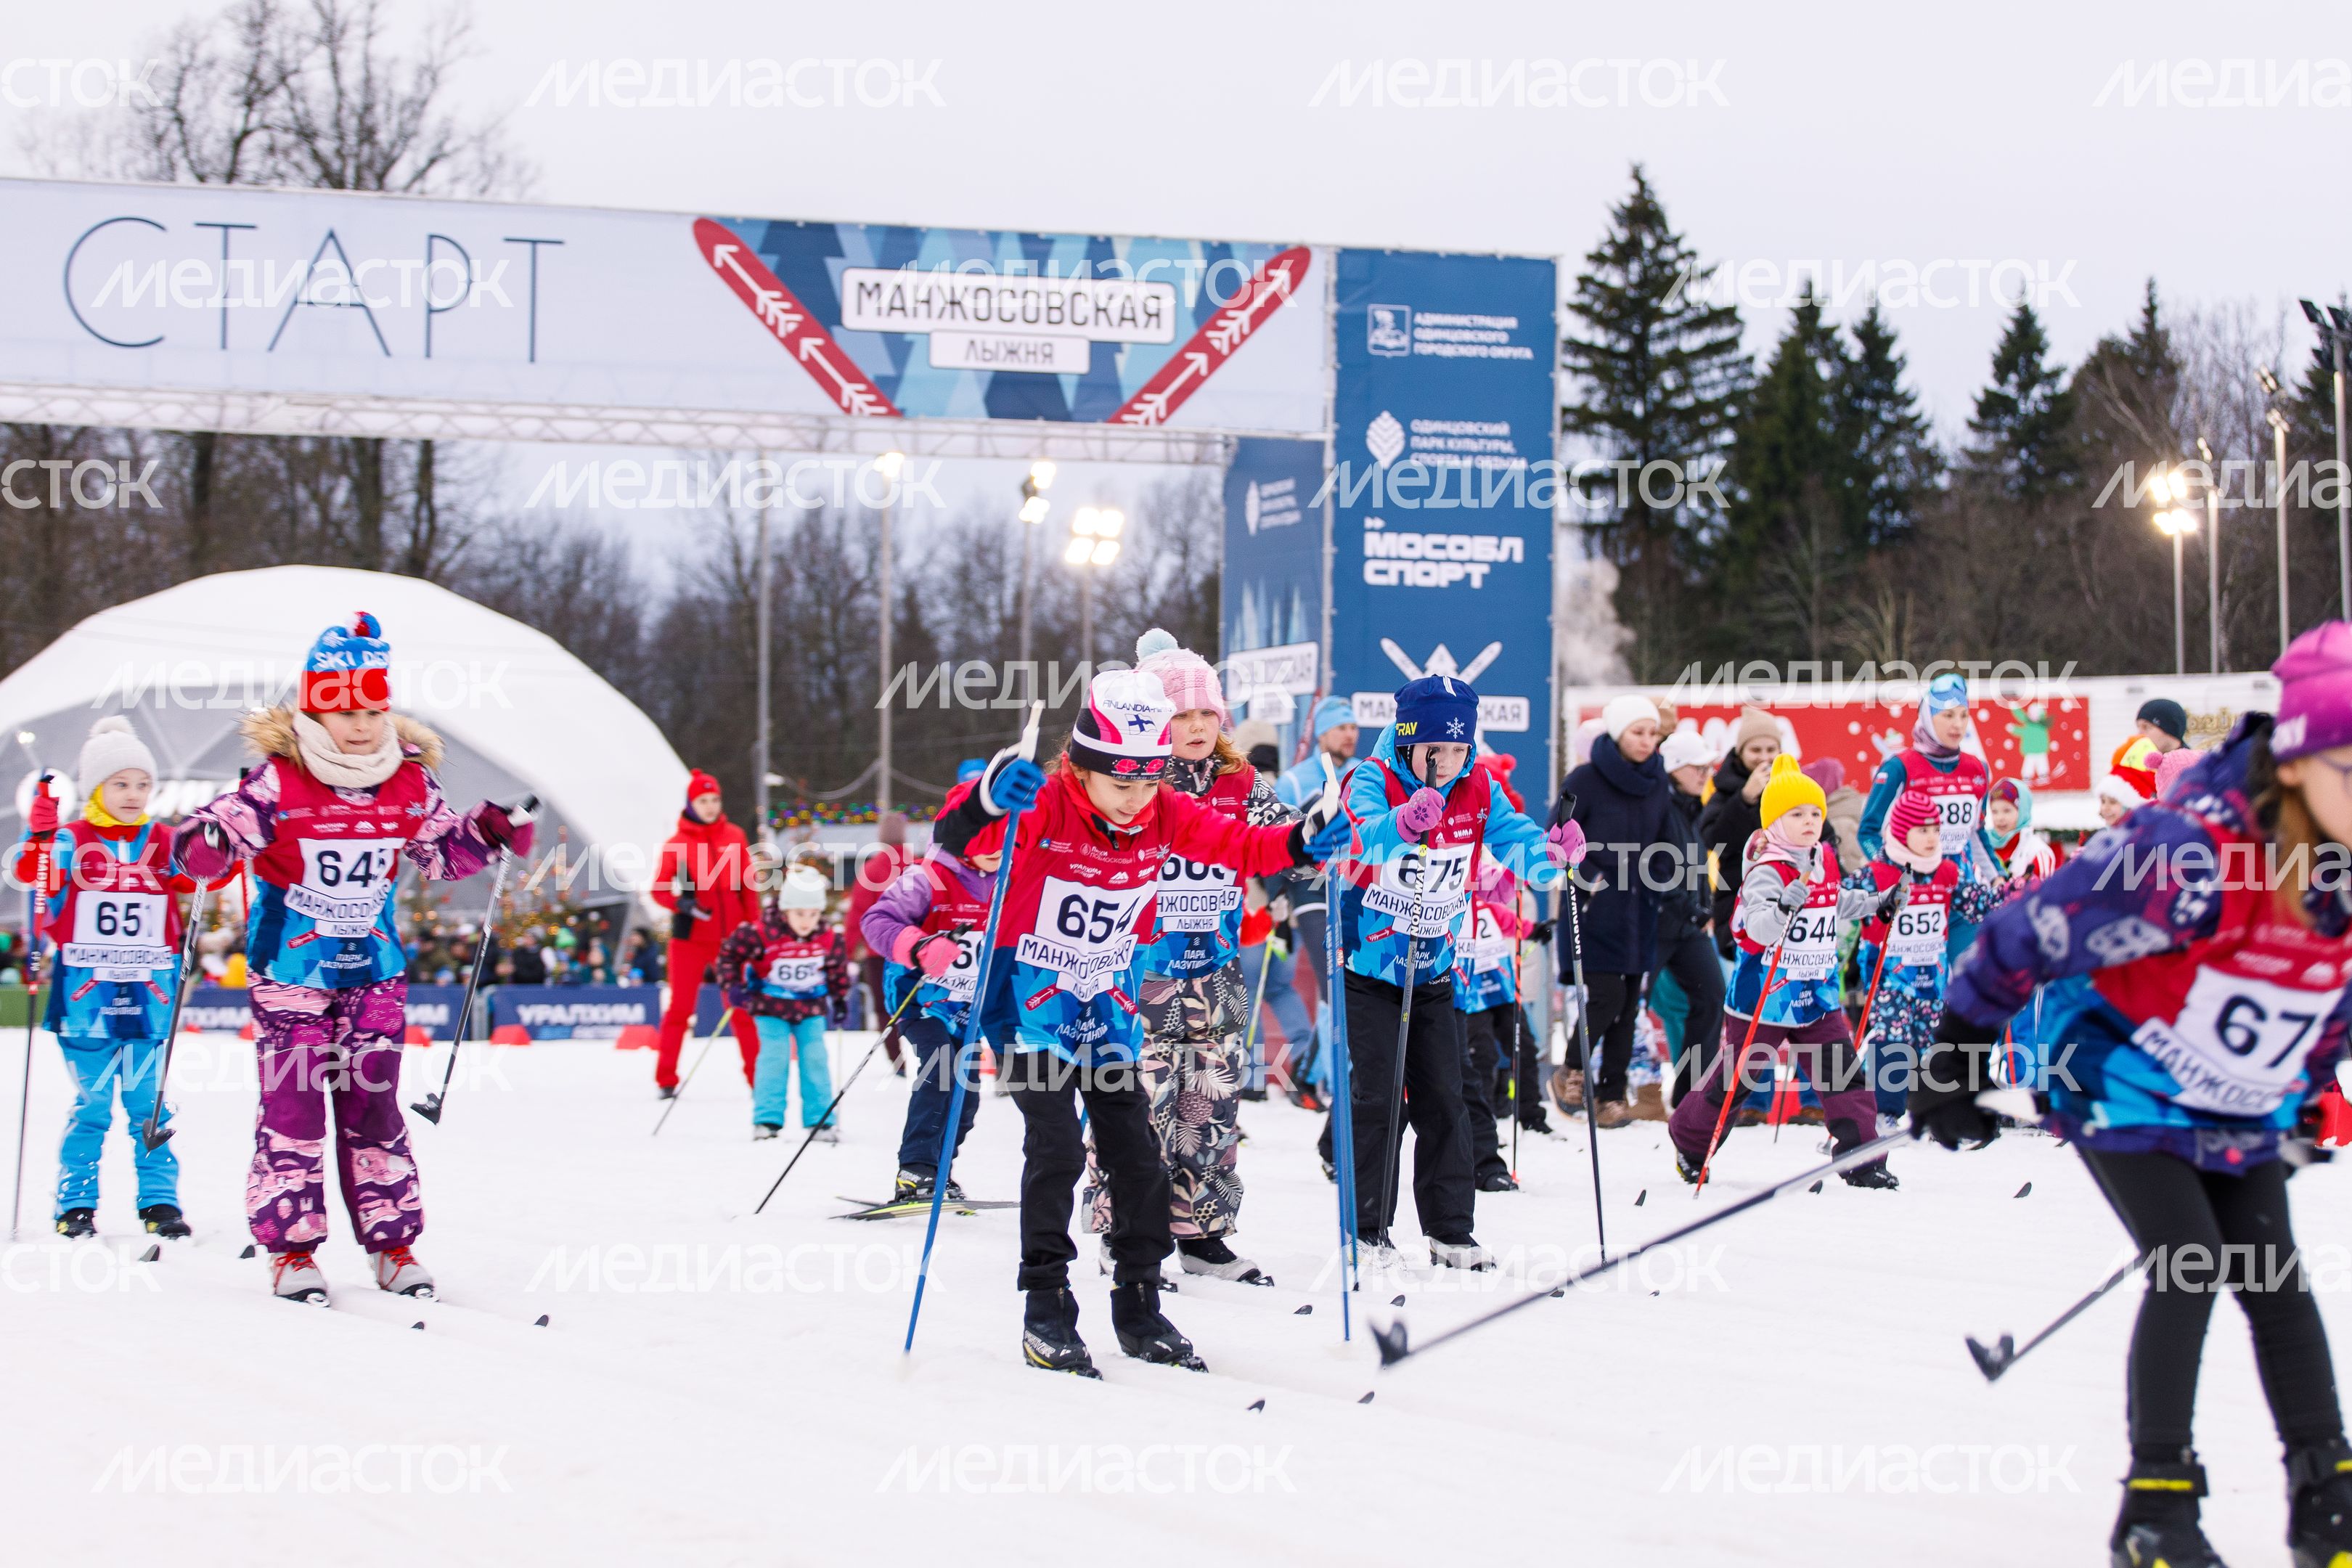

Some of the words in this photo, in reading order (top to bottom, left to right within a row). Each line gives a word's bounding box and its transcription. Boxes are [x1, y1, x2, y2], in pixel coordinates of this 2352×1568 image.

[63, 216, 565, 364] СТАРТ
[857, 282, 1162, 330] МАНЖОСОВСКАЯ
[964, 340, 1055, 364] ЛЫЖНЯ
[1364, 531, 1524, 563] МОСОБЛ
[1363, 558, 1491, 589] СПОРТ
[1360, 699, 1522, 725] МАНСКАЯ
[1398, 853, 1468, 893] 675
[1410, 863, 1426, 934] NORDWAY
[1057, 893, 1141, 944] 654
[1177, 918, 1214, 929] ЛЫЖНЯ
[1788, 915, 1836, 943] 644
[1898, 911, 1940, 936] 652
[1183, 950, 1206, 960] ПАРК
[1394, 955, 1437, 969] ЛАЗТИНОЙ
[516, 1003, 647, 1026] УРАЛХИМ
[2216, 993, 2317, 1070] 67
